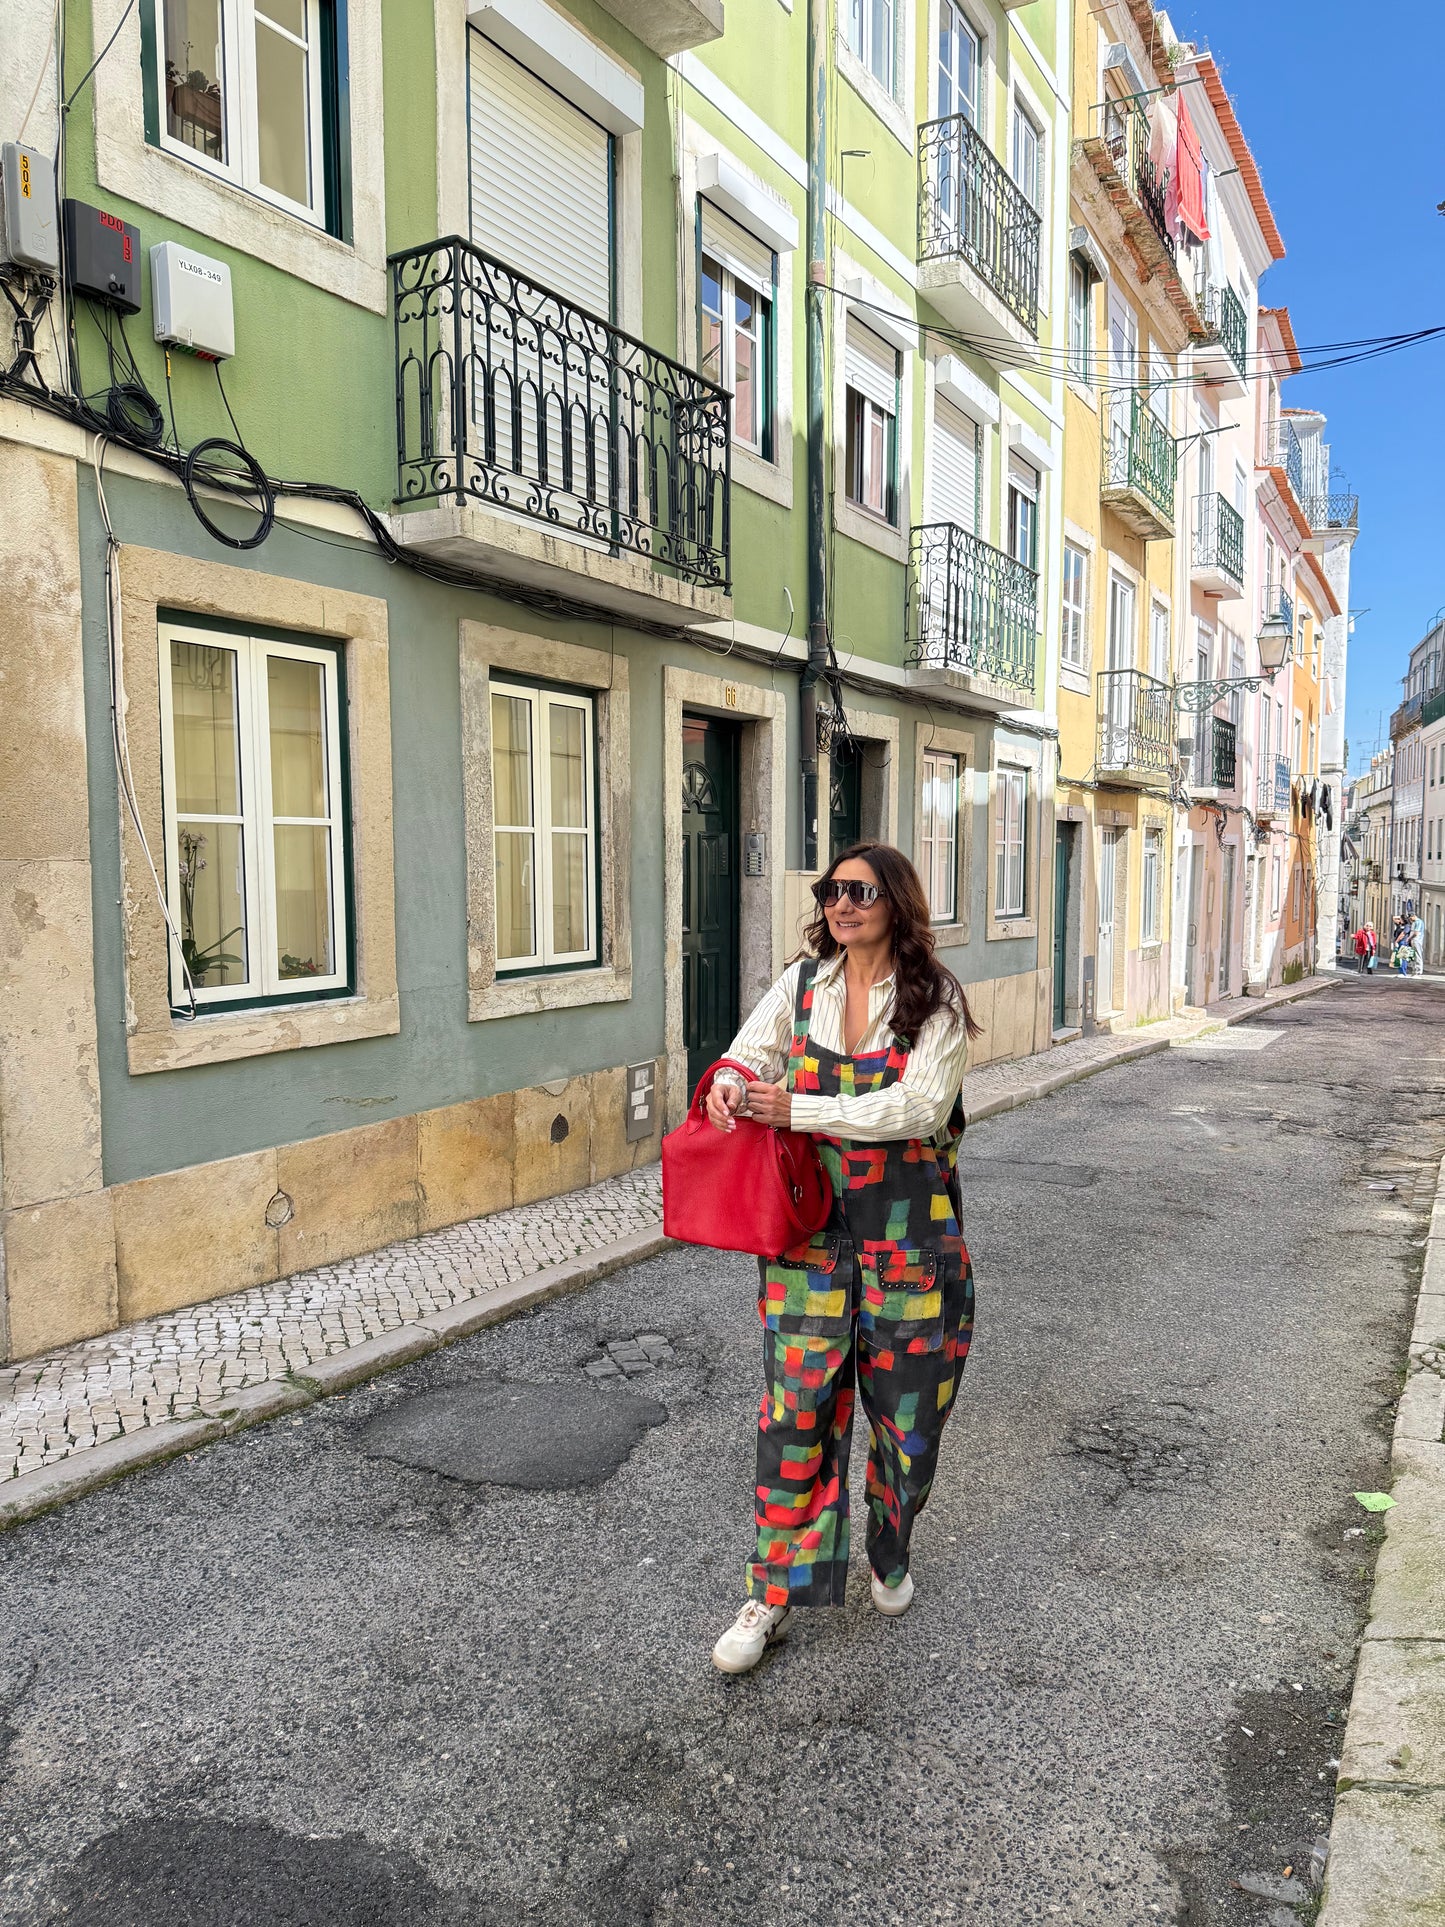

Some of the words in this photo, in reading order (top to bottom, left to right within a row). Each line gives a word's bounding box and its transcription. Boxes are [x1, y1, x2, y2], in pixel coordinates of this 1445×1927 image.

[22, 155, 30, 197] 504
[124, 236, 131, 261] 13
[178, 259, 222, 283] YLX08-349
[725, 685, 737, 707] 66
